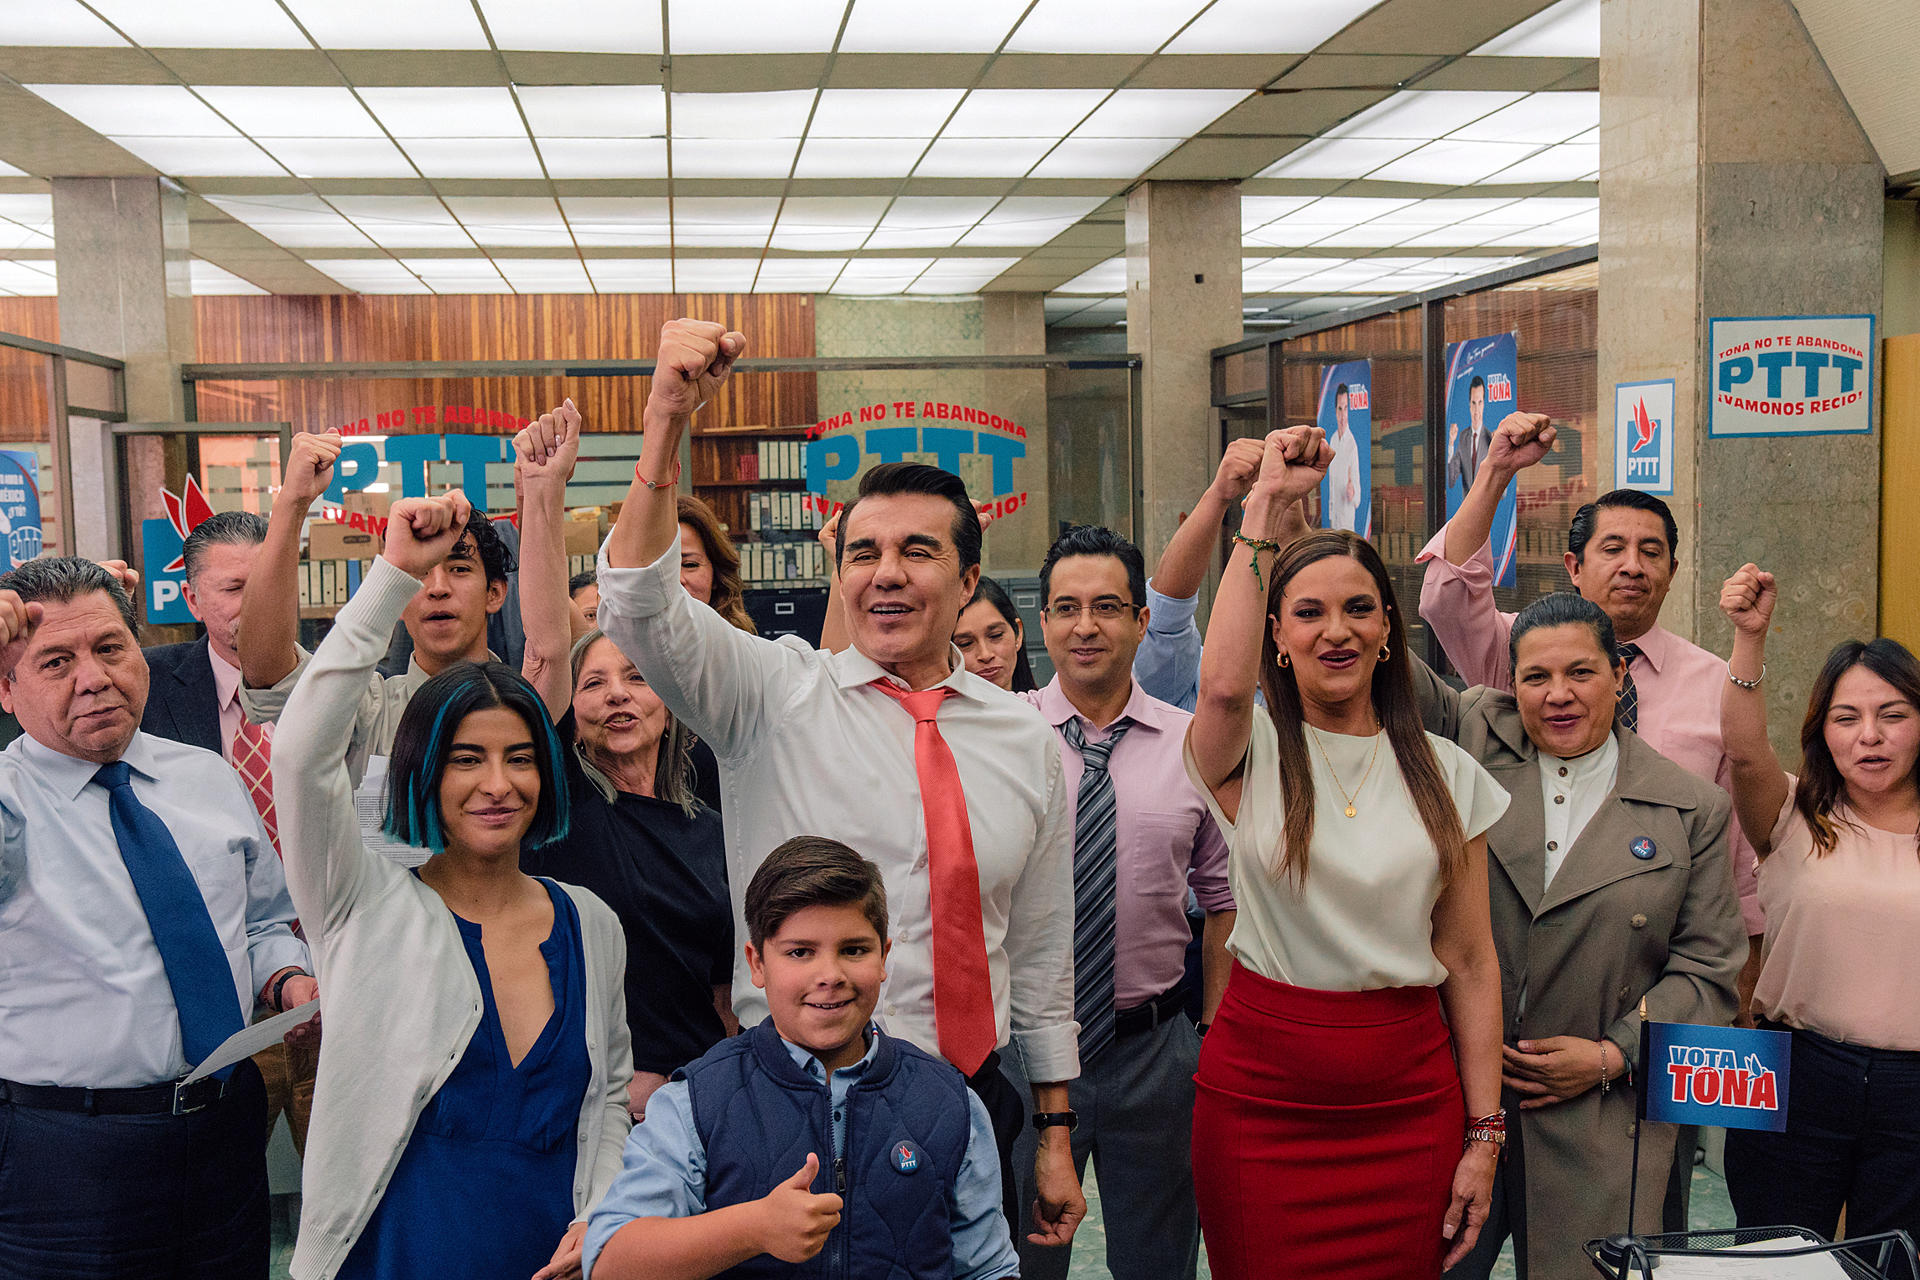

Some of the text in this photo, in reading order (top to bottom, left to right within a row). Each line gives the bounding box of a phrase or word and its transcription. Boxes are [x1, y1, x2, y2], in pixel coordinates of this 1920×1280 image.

[1718, 335, 1864, 360] TONA NO TE ABANDONA
[1718, 351, 1864, 399] PTTT
[1349, 391, 1368, 410] TONA
[1487, 381, 1511, 402] TONA
[1717, 390, 1864, 417] ¡VAMONOS RECIO!
[376, 409, 405, 430] NO
[411, 405, 437, 425] TE
[803, 401, 1028, 439] TONA NO TE ABANDONA
[322, 433, 516, 512] PTT
[806, 427, 1026, 497] PTTT
[1627, 457, 1660, 477] PTTT
[981, 491, 1028, 521] CIO!
[1669, 1045, 1736, 1069] VOTA
[1667, 1062, 1778, 1111] TONA
[901, 1160, 916, 1169] PTTT
